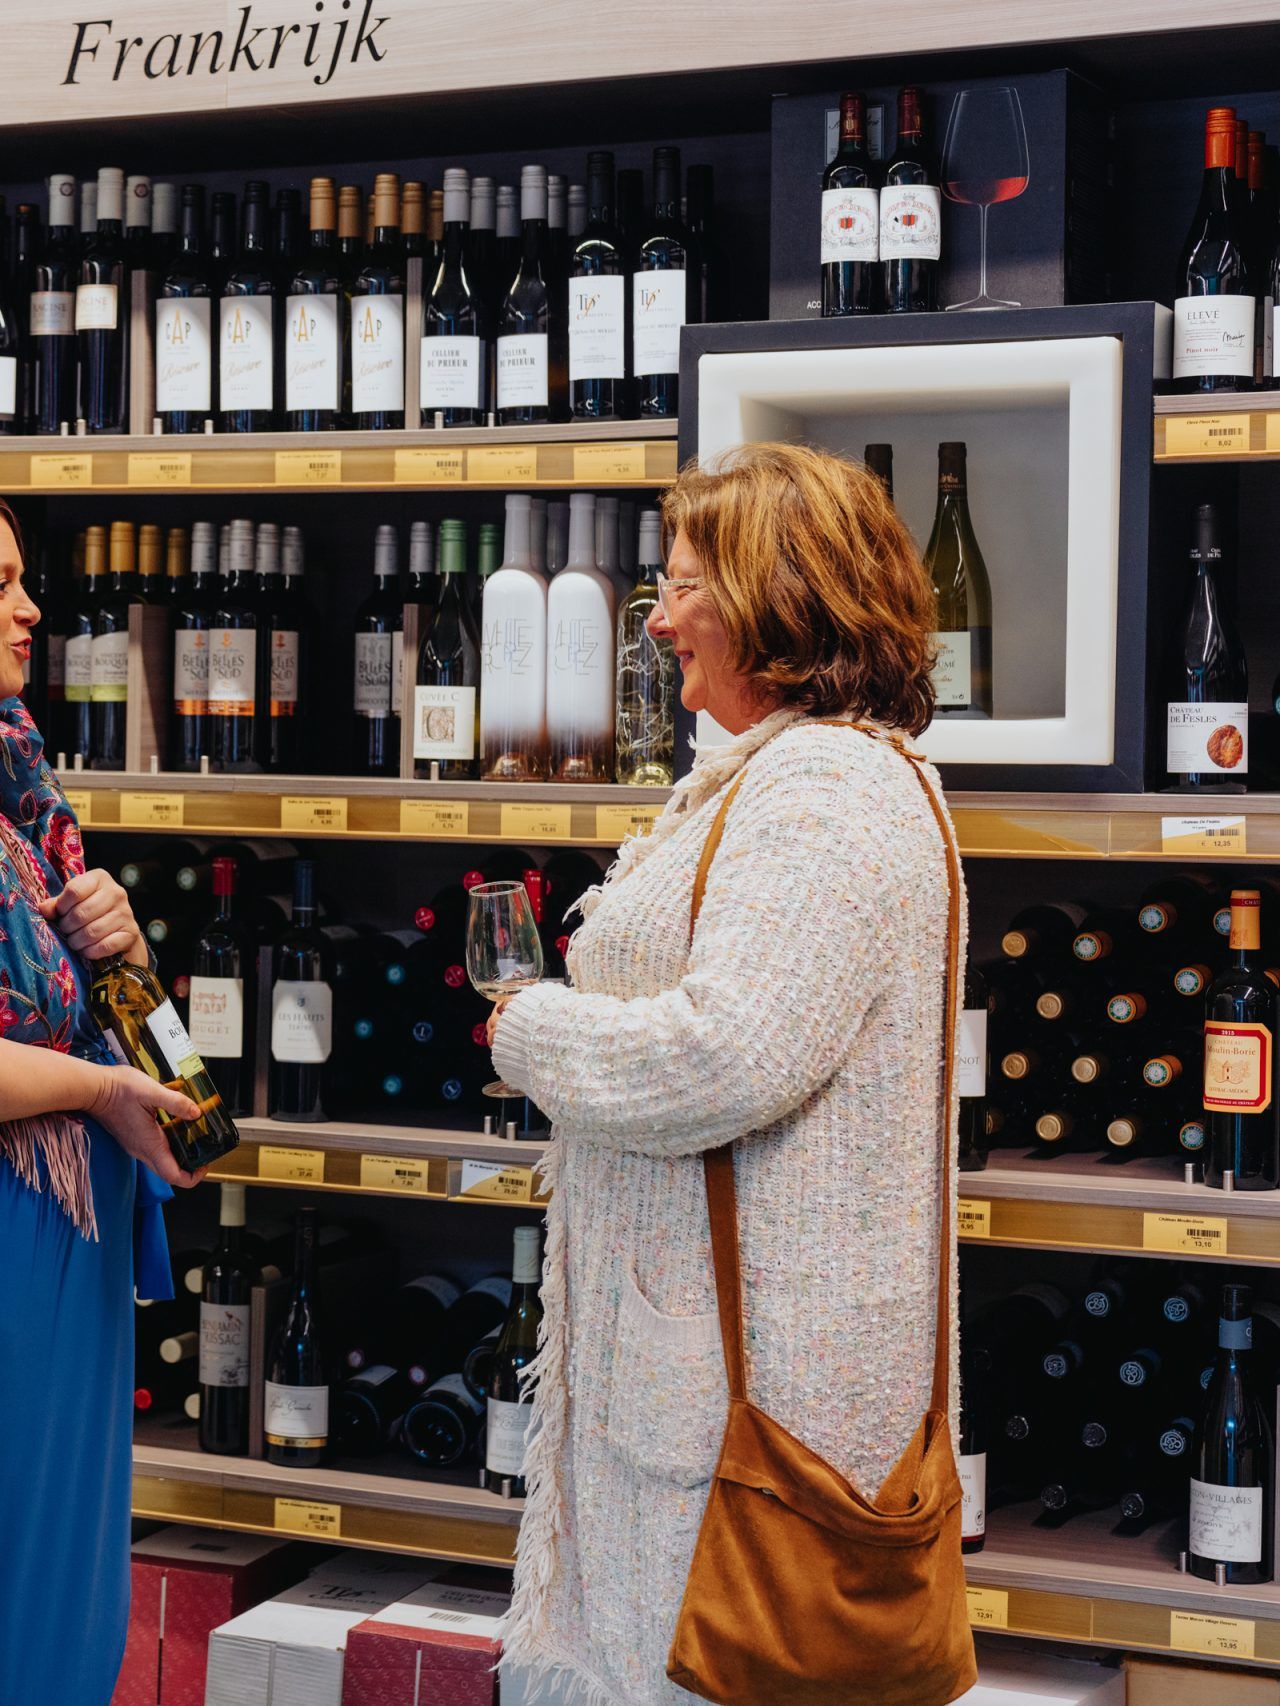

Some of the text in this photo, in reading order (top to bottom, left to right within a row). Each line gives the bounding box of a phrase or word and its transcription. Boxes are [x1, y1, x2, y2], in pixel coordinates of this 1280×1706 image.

[60, 0, 391, 85] Frankrijk
[166, 308, 192, 345] CAP
[227, 307, 252, 344] CAP
[292, 305, 317, 343] CAP
[358, 306, 383, 343] CAP
[431, 350, 460, 358] CELLIER
[438, 359, 469, 368] PRIEUR
[507, 357, 536, 367] PRIEUR
[212, 654, 245, 669] BELLES
[1170, 712, 1218, 724] DE FESLES
[1214, 840, 1231, 848] 12,35
